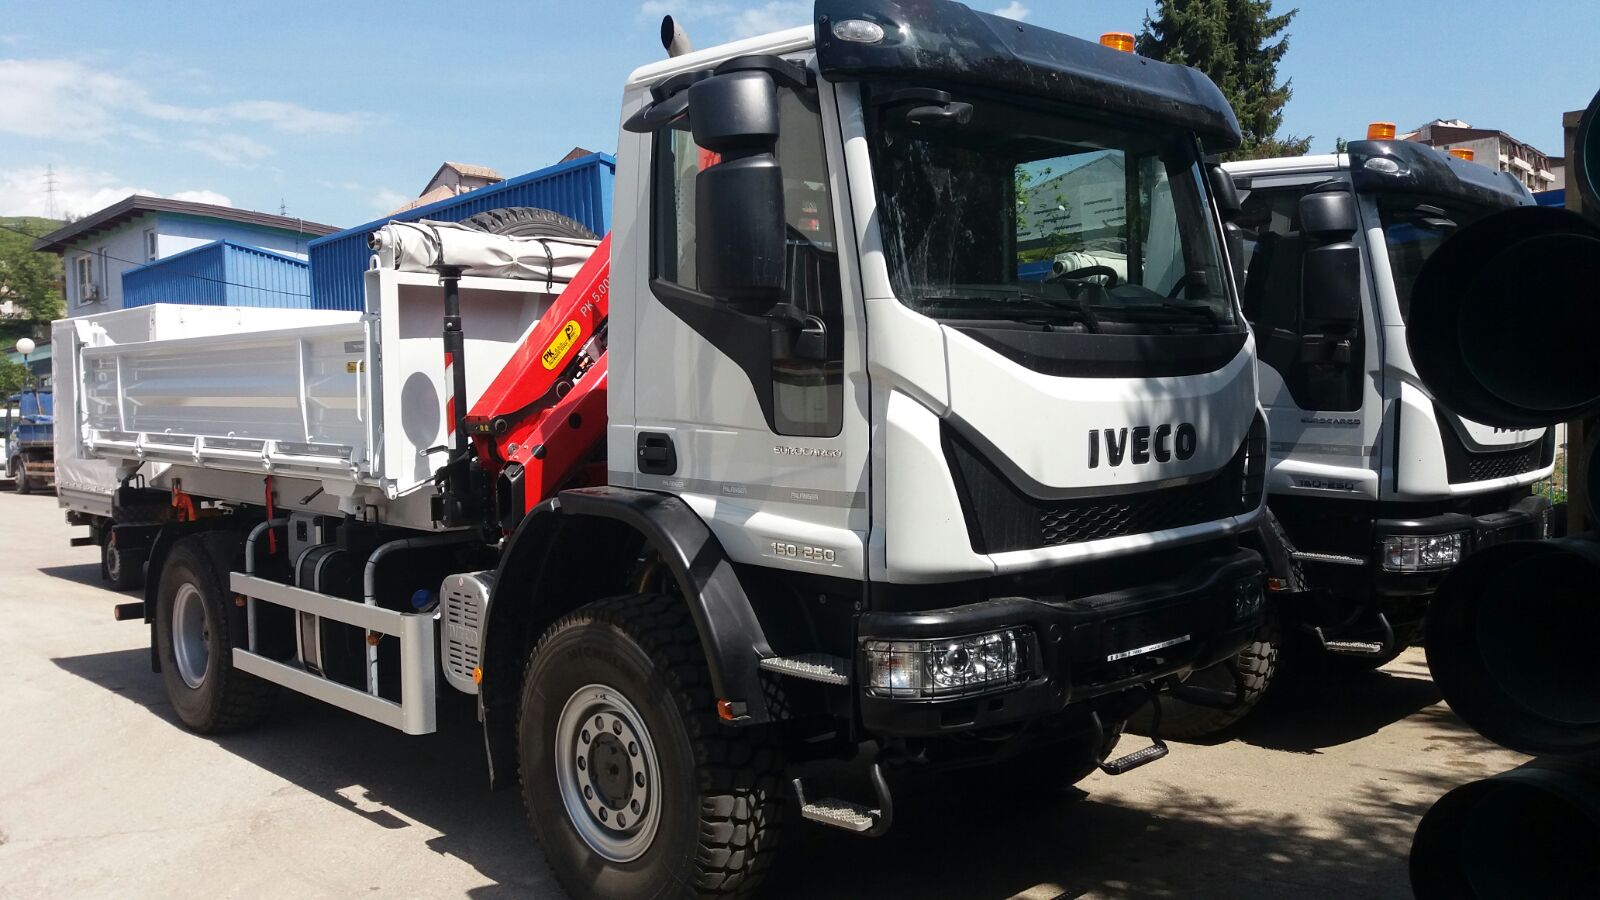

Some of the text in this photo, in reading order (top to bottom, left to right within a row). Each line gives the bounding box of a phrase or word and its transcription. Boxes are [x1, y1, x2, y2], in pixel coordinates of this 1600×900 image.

[581, 275, 610, 317] PK 5.00
[543, 349, 554, 362] PK
[773, 445, 843, 458] EUROCARGO
[1088, 422, 1197, 469] IVECO
[770, 542, 836, 562] 150-250
